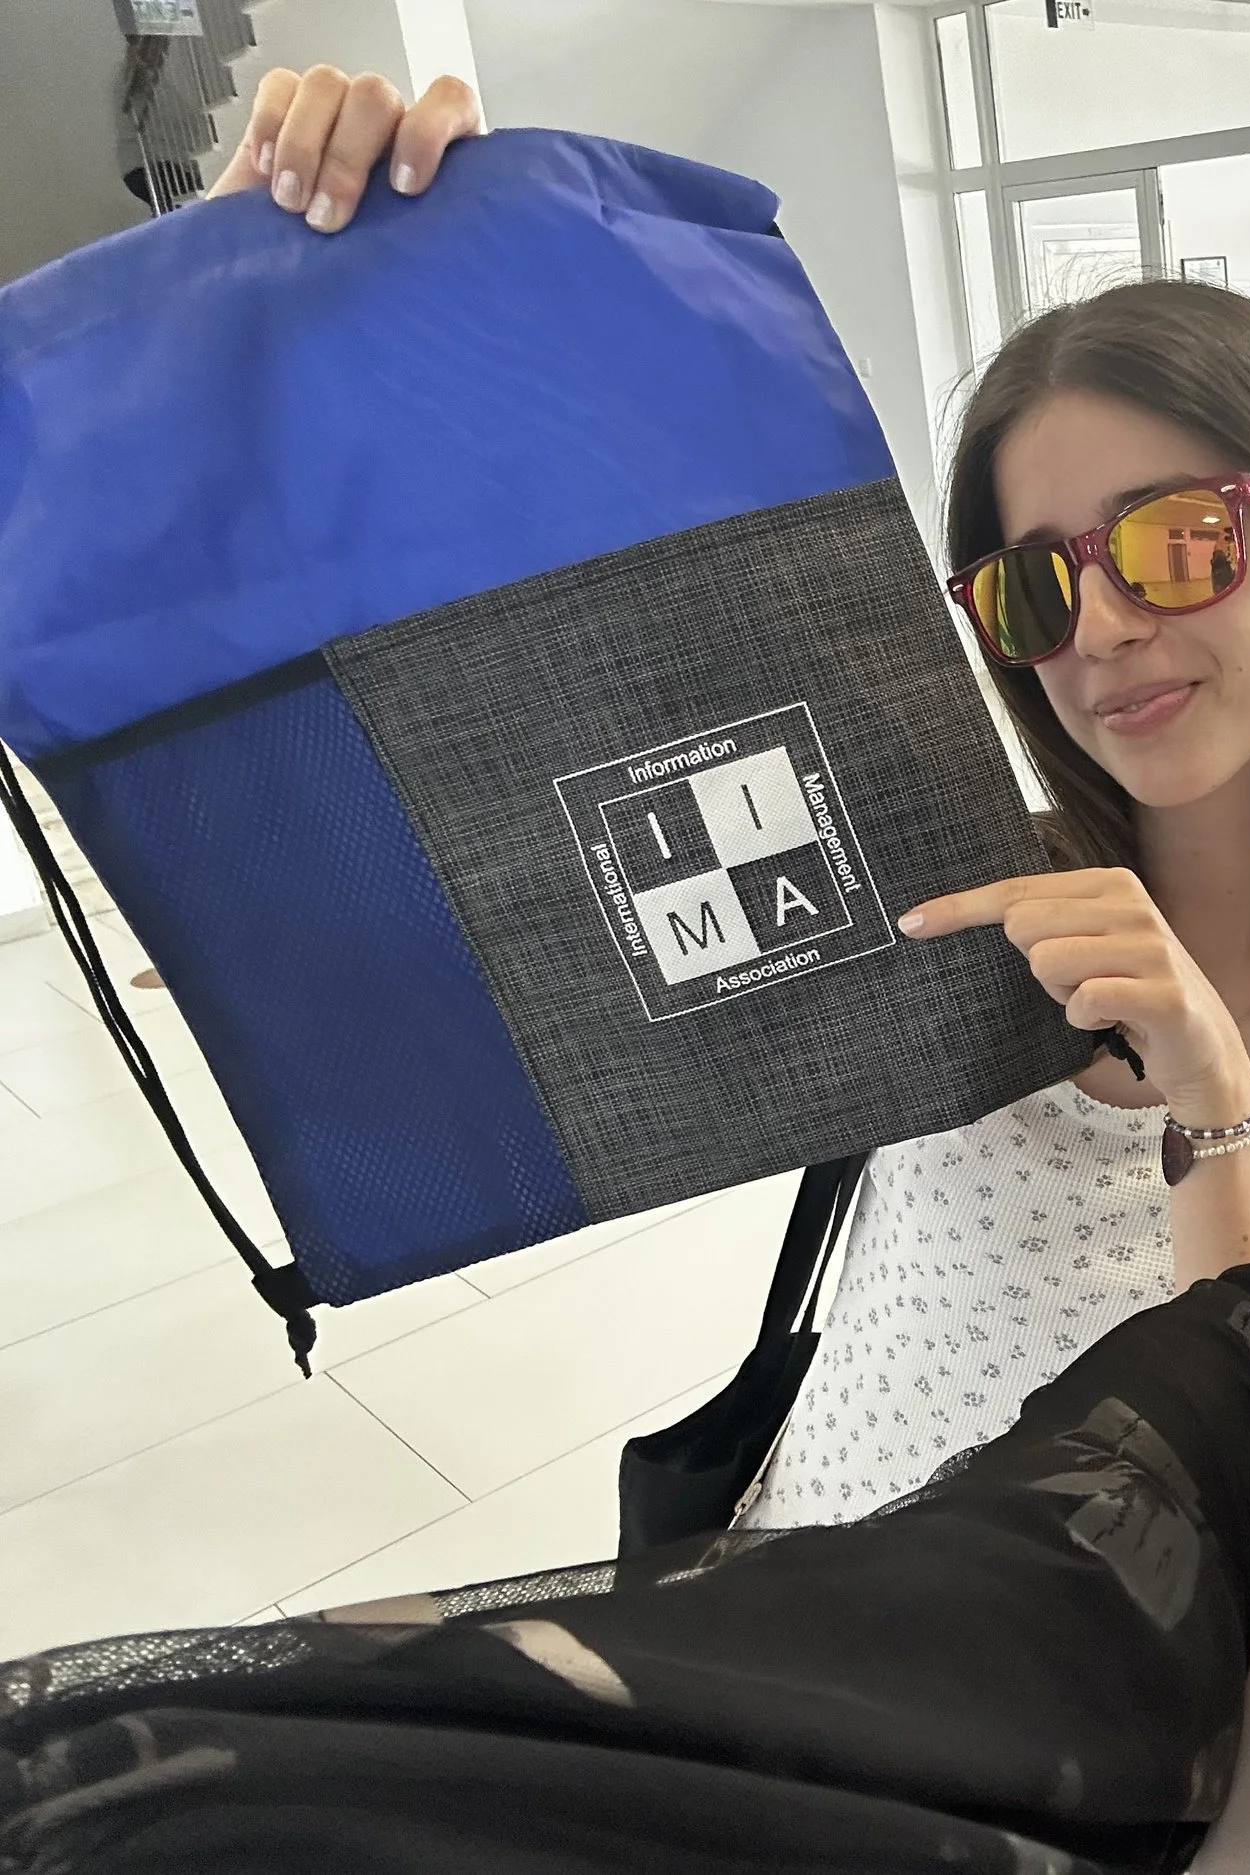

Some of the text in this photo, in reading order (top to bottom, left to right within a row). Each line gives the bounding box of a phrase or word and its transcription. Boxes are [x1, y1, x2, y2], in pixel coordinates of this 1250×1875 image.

[1057, 1, 1081, 19] EXIT
[627, 737, 738, 784] Information
[646, 783, 763, 860] I I
[802, 772, 862, 893] Management
[590, 843, 648, 957] International
[666, 875, 820, 956] M A
[715, 947, 822, 994] Association
